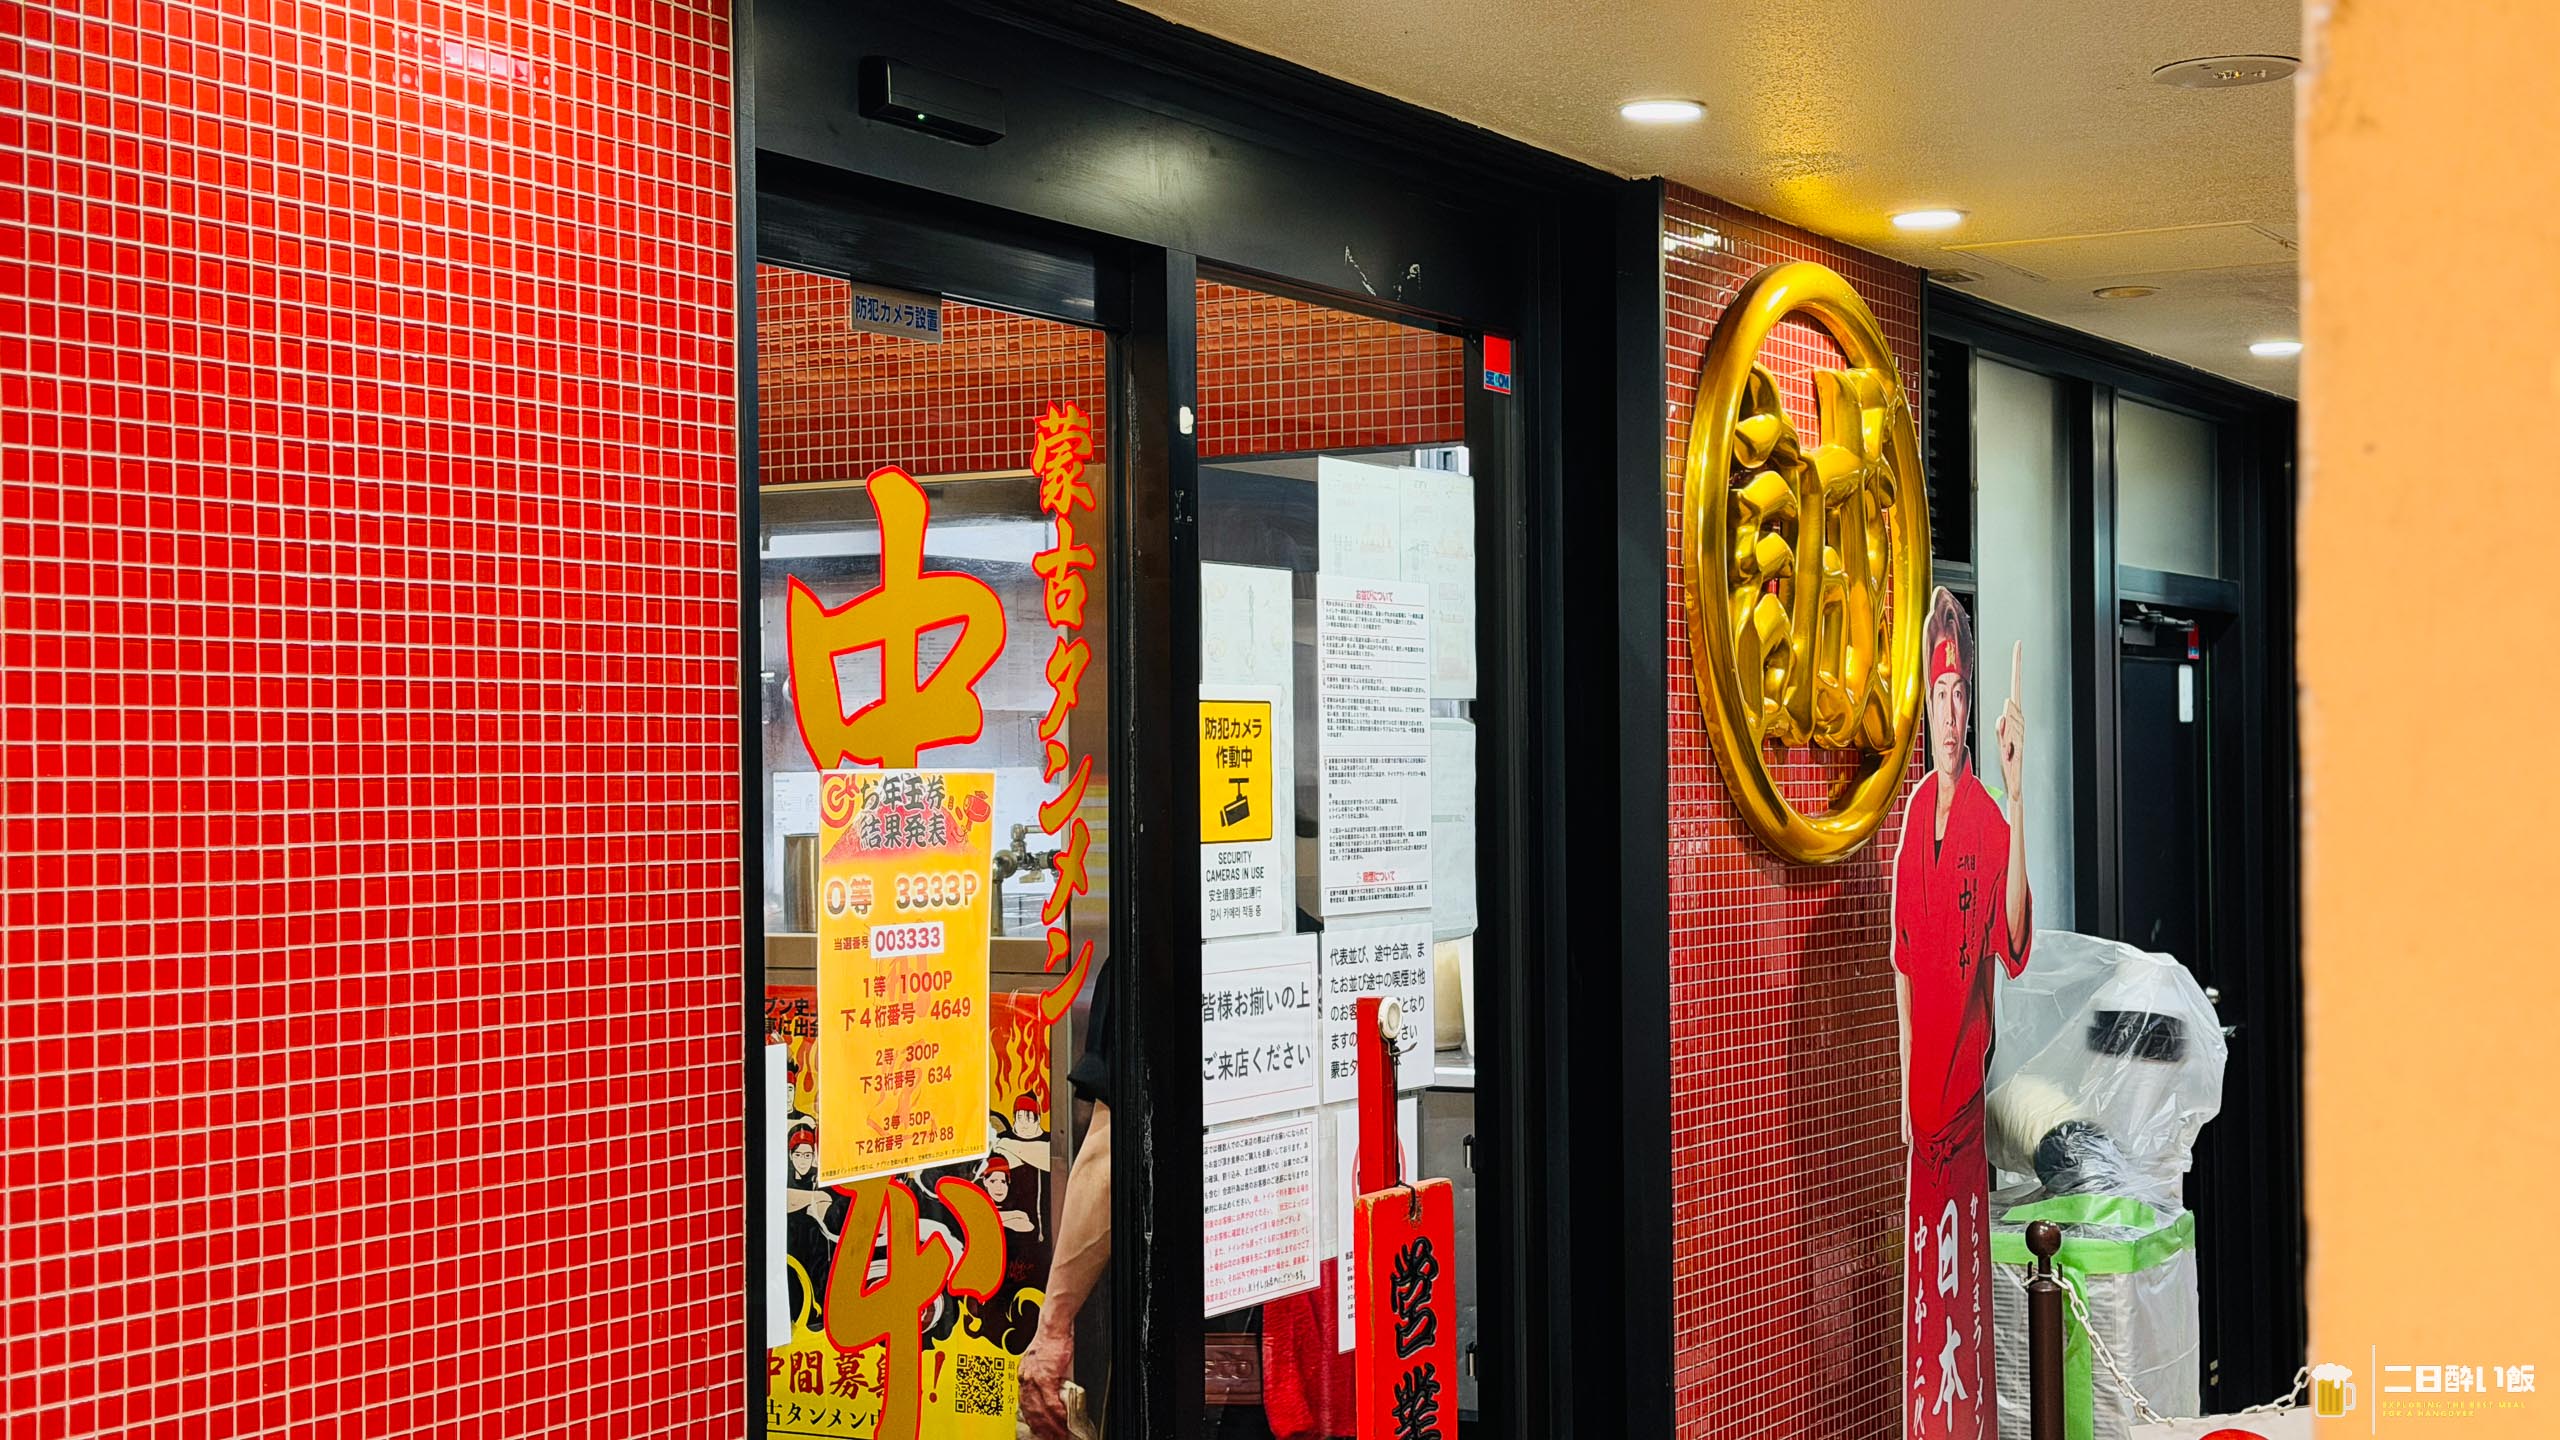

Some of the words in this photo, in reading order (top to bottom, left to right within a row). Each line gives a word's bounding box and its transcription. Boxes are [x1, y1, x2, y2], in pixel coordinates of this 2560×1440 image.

[854, 294, 939, 333] 防犯カメラ設置
[1030, 400, 1097, 1025] 蒙古タンメン
[1205, 717, 1262, 740] 防犯カメラ
[1216, 745, 1252, 768] 作動中
[860, 775, 946, 811] お年玉券
[860, 813, 947, 848] 結果発表
[1218, 851, 1252, 865] SECURITY
[1206, 867, 1240, 882] CAMERAS
[1242, 867, 1249, 880] IN
[1251, 866, 1264, 879] USE
[896, 873, 977, 909] 3333P
[834, 935, 869, 951] 当選番号
[875, 926, 941, 953] 003333
[1959, 878, 1972, 981] 中本
[1330, 942, 1425, 966] 代表並び、途中合流、ま
[863, 975, 886, 998] 1等
[900, 970, 952, 994] 1000P
[1330, 968, 1426, 994] たお並び途中の喫煙は他
[840, 1001, 916, 1032] 下4桁番号
[930, 996, 971, 1021] 4649
[1201, 981, 1311, 1023] 皆様お揃いの上
[875, 1047, 895, 1066] 2等
[905, 1043, 940, 1063] 300P
[1203, 1041, 1312, 1081] ご来店ください
[859, 1069, 916, 1094] 下3桁番号
[928, 1065, 952, 1085] 634
[909, 1111, 931, 1127] 50P
[855, 1134, 904, 1156] 下2桁番号
[1913, 1215, 1928, 1440] 中本二代
[1932, 1199, 1969, 1432] 日本
